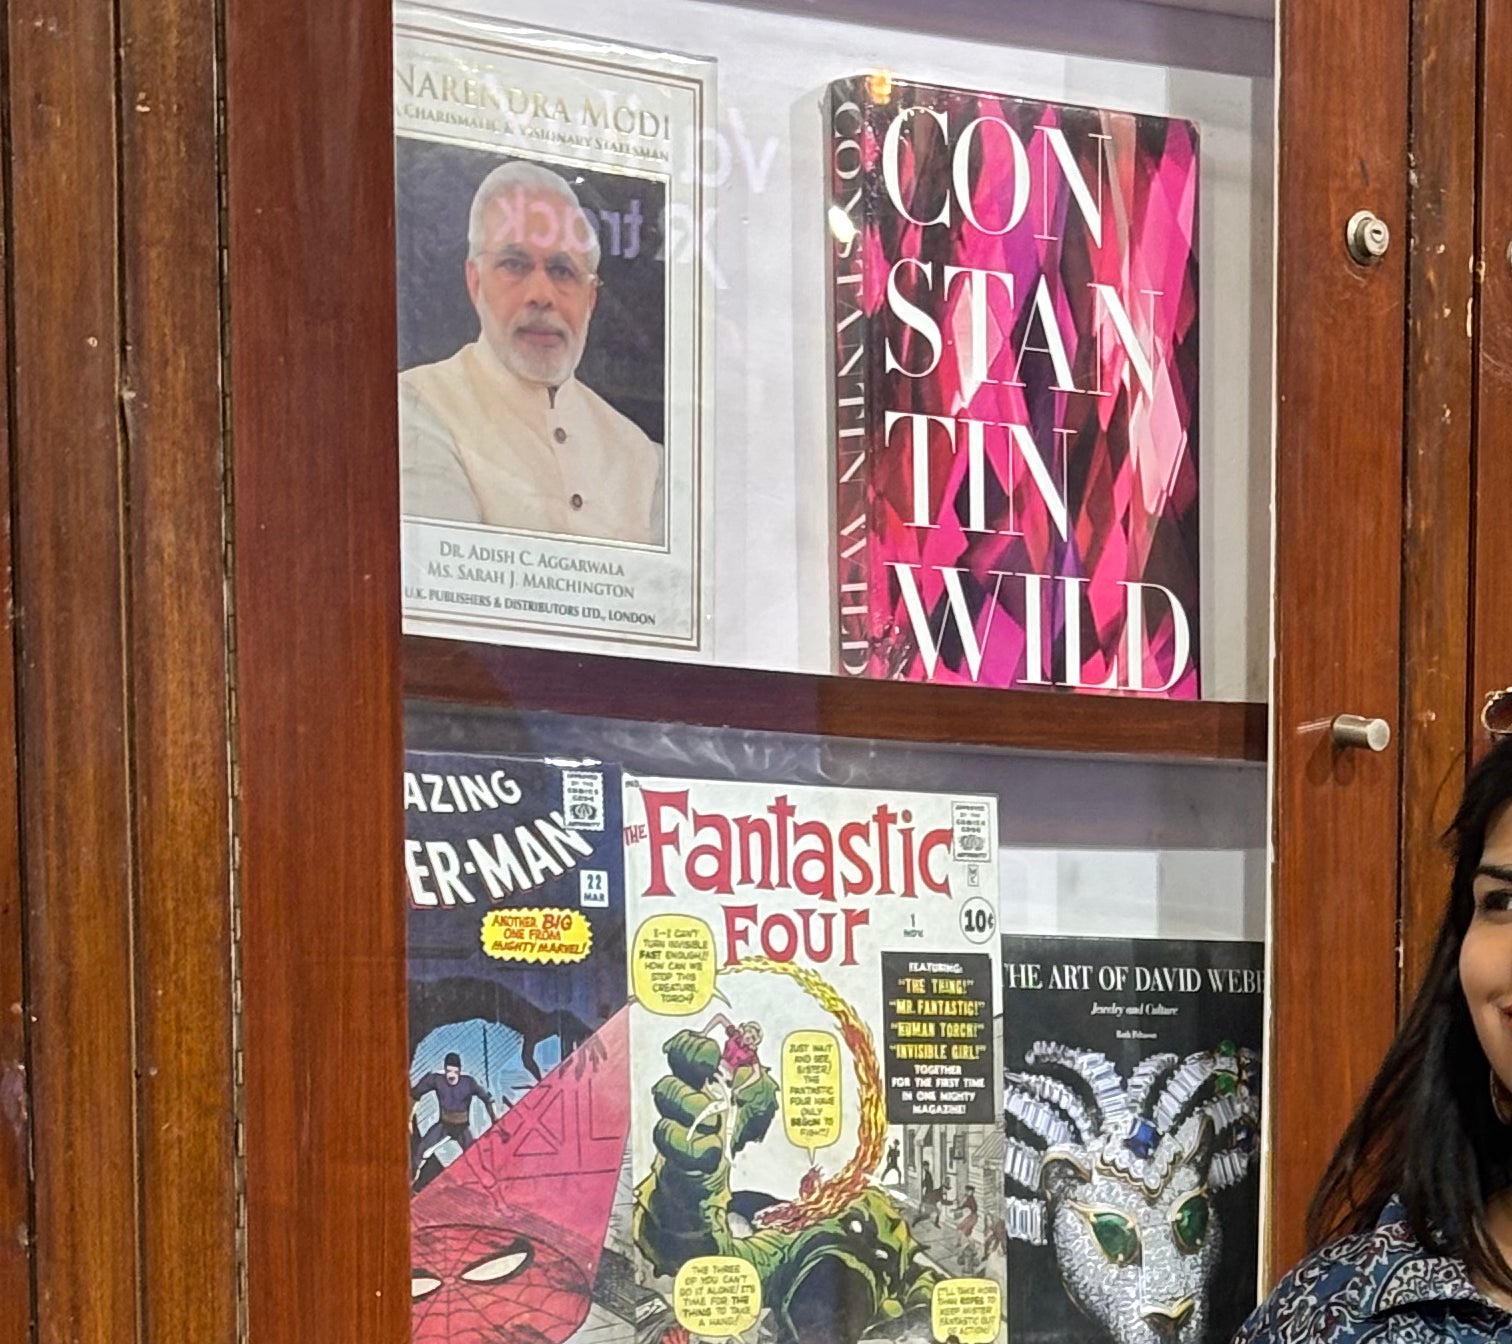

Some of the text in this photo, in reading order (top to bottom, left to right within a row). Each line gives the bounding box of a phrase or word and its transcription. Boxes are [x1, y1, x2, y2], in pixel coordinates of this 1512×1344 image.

[396, 63, 571, 124] NARENDRA
[581, 96, 671, 141] MODI
[882, 106, 1113, 248] CON
[884, 256, 1165, 400] STAN
[884, 410, 1079, 543] TIN
[503, 597, 580, 618] DISTRIBUTORS
[607, 608, 657, 626] LONDON
[883, 561, 1191, 693] WILD
[404, 770, 522, 813] AZING
[623, 823, 648, 846] THE
[639, 787, 955, 902] Fantastic
[586, 873, 602, 890] 22
[491, 913, 573, 931] ANOTHER BIG
[503, 927, 562, 941] ONE FROM
[1047, 964, 1094, 991] ART
[1098, 965, 1129, 992] OF
[1134, 966, 1202, 993] DAVID
[891, 1076, 912, 1088] FOR
[914, 1077, 933, 1088] THE
[913, 1063, 962, 1076] TOGETHER
